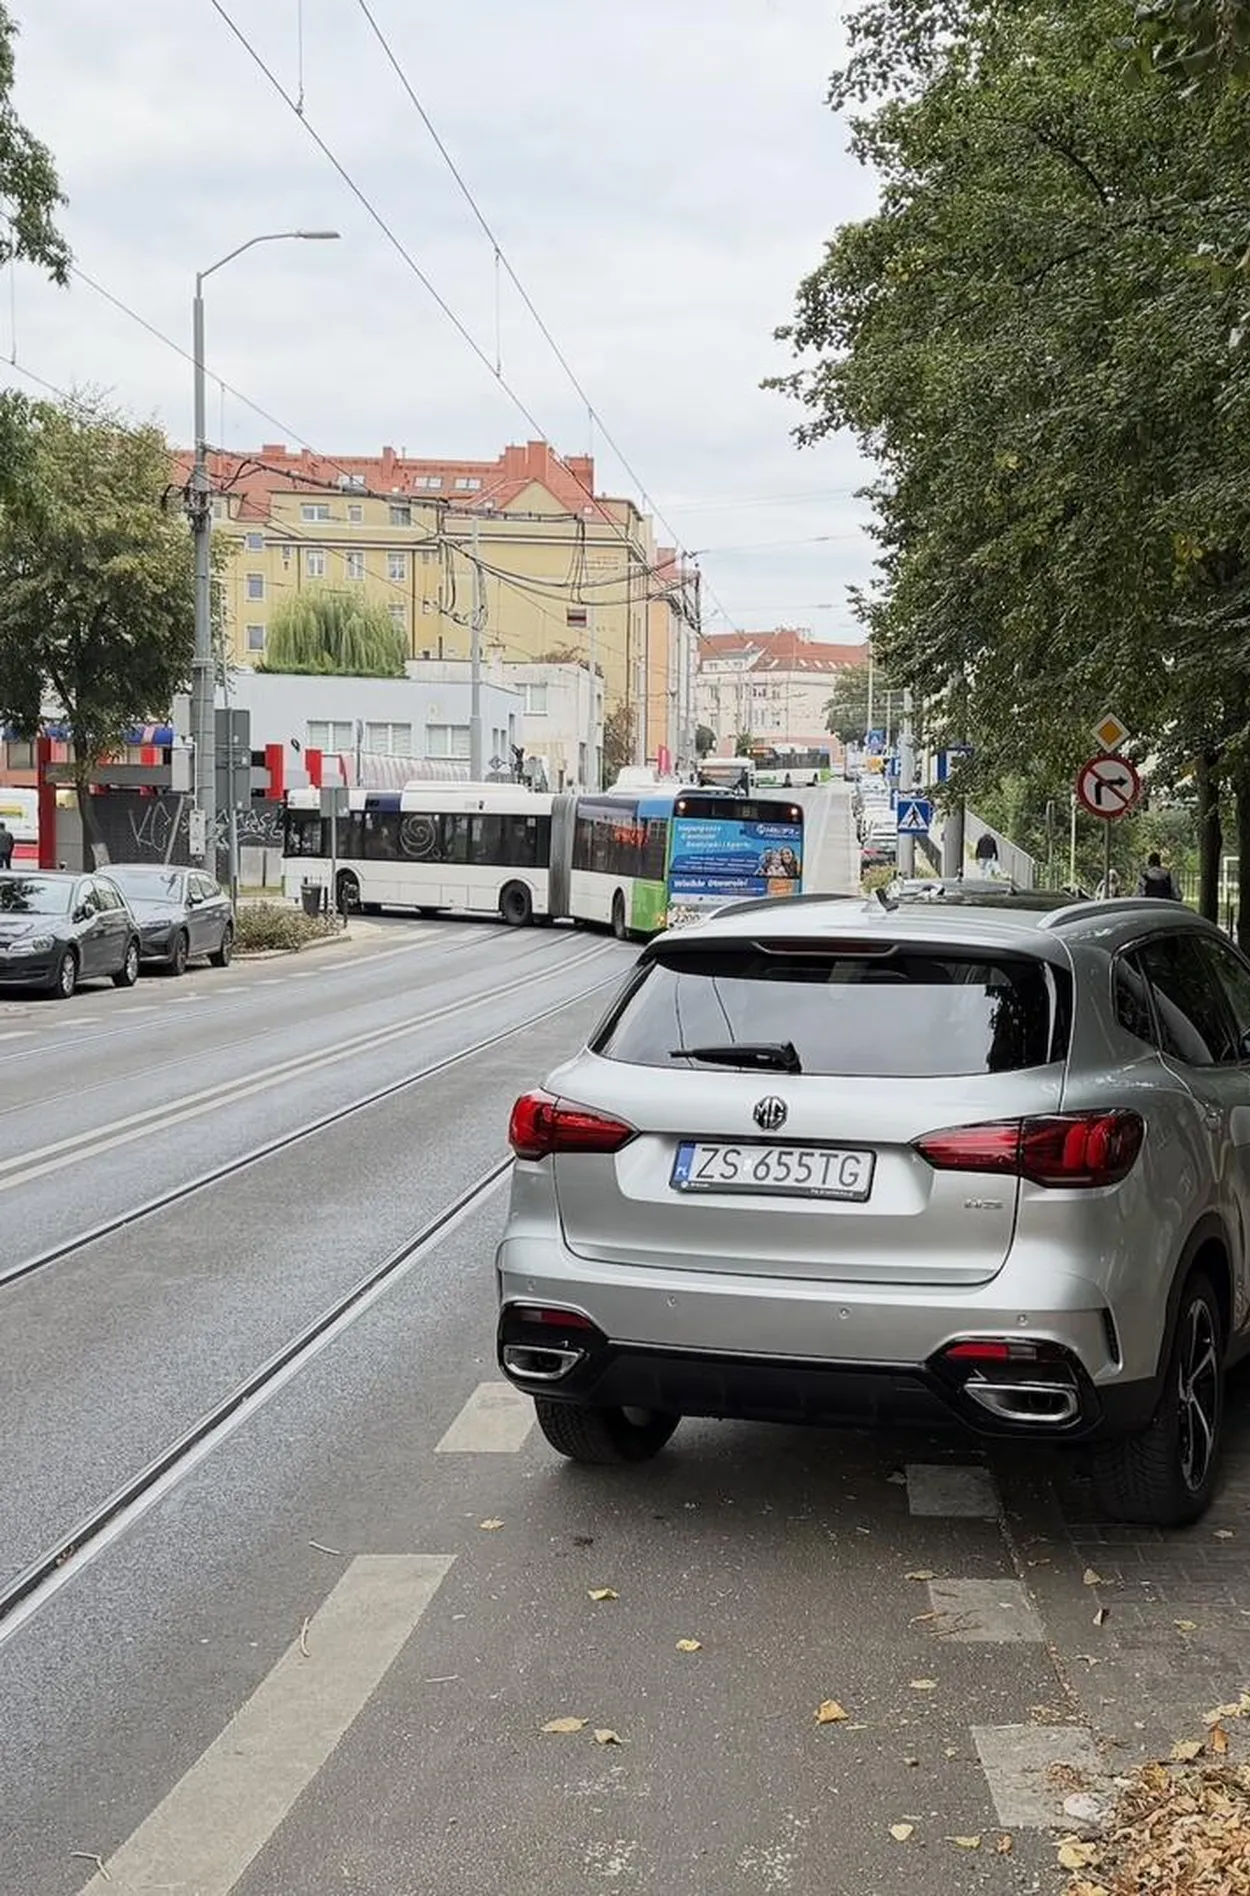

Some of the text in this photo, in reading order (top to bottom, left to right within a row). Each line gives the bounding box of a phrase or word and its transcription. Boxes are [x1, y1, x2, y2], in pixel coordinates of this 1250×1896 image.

[753, 1096, 788, 1130] MG
[696, 1147, 862, 1188] ZS 655TG
